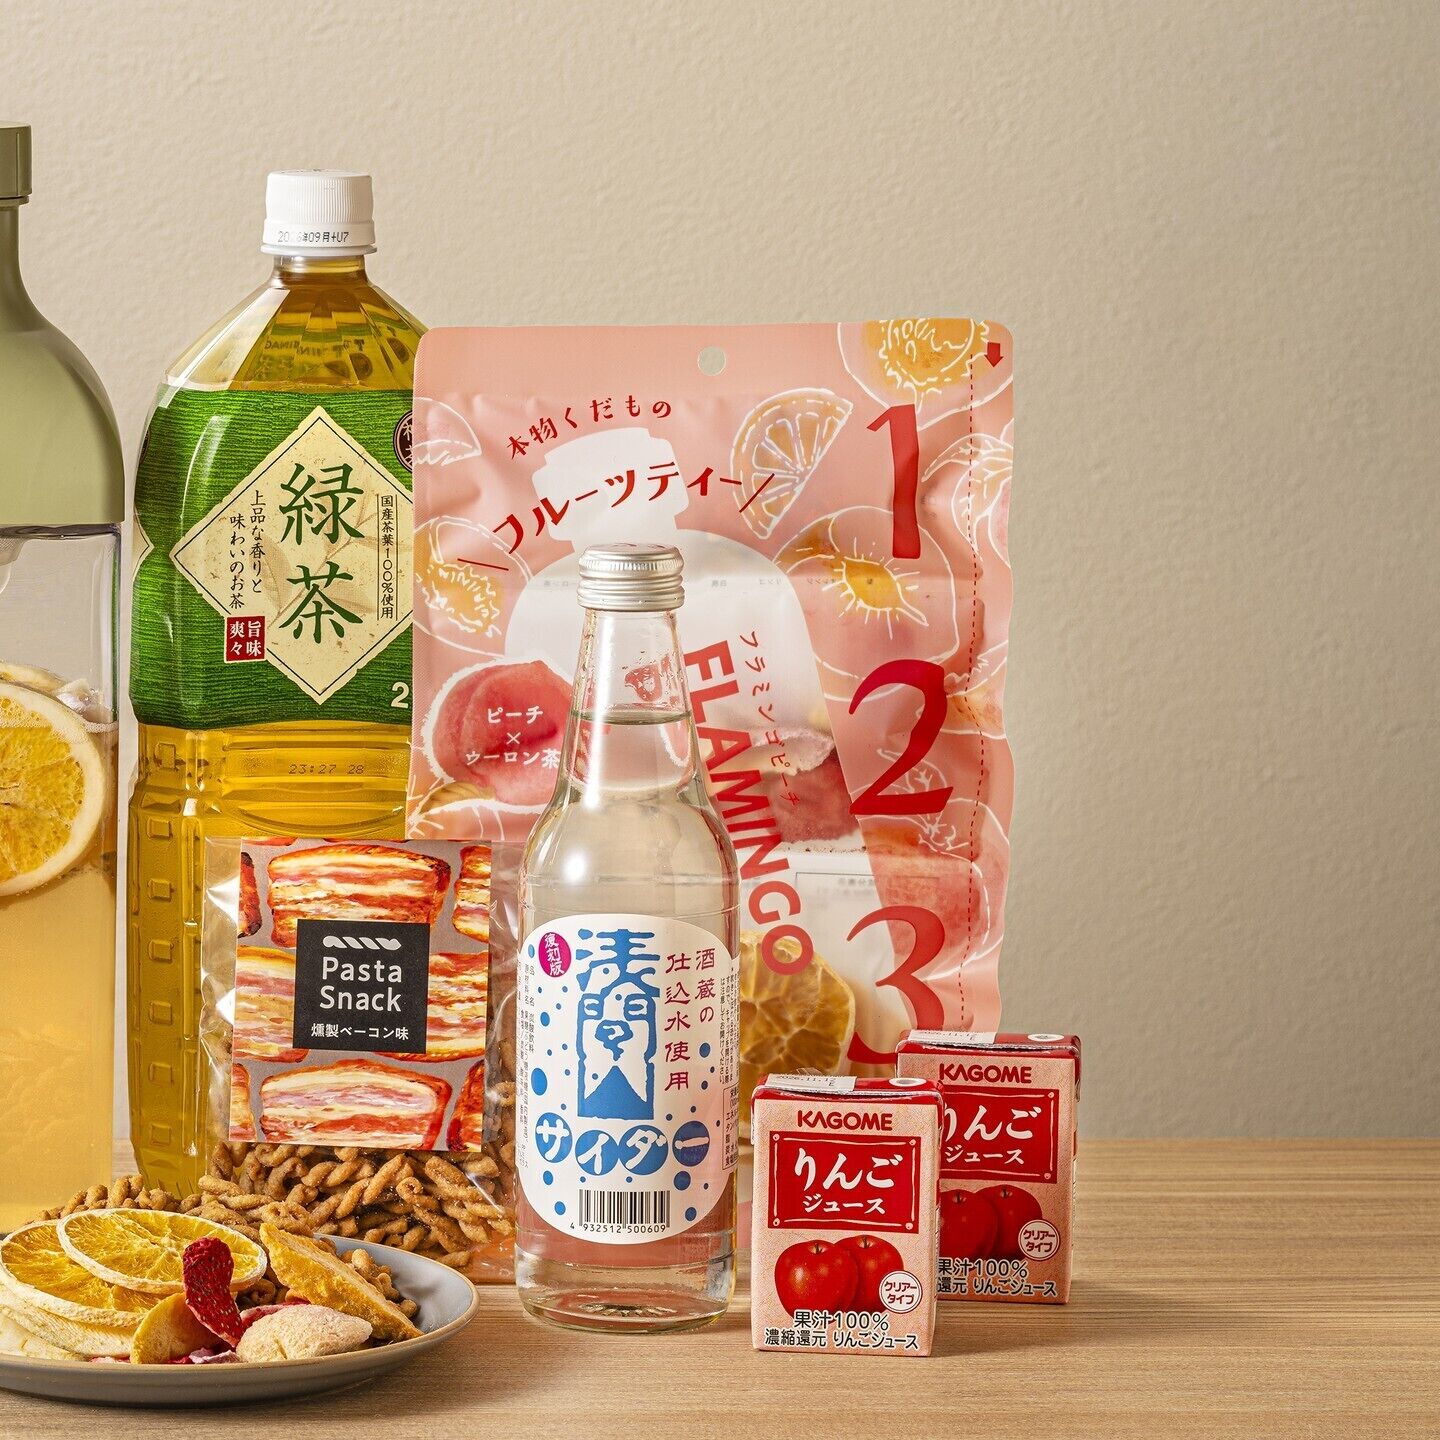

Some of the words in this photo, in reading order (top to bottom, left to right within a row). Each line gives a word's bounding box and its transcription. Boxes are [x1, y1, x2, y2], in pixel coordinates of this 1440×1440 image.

[506, 394, 672, 460] 本物くだもの
[866, 404, 921, 559] 1
[492, 461, 742, 554] フルーツティー
[250, 490, 266, 594] 上品な香りと
[279, 463, 365, 643] 緑茶
[229, 513, 245, 609] 味わいのお茶
[380, 495, 394, 619] 国産茶葉100%使用
[246, 620, 262, 657] 旨味
[487, 705, 544, 724] ピーチ
[739, 630, 800, 807] フラミンゴピーチ
[848, 659, 954, 816] 2
[288, 764, 337, 774] 23:27
[465, 748, 560, 769] ウーロン茶
[683, 640, 815, 975] FLAMINGO
[544, 933, 565, 976] 復刻版
[322, 956, 402, 983] Pasta
[695, 948, 716, 1022] 酒蔵の
[319, 986, 402, 1012] Snack
[310, 1022, 409, 1041] 燻製ベーコン味
[664, 953, 691, 1092] 仕込水使用
[939, 1063, 1032, 1084] KAGOME
[797, 1110, 893, 1132] KAGOME
[537, 1118, 709, 1174] サイダー
[945, 1144, 1025, 1166] ジュース
[794, 1147, 902, 1192] りんご
[802, 1193, 886, 1215] ジュース
[583, 1223, 622, 1235] 932512
[627, 1223, 667, 1235] 500609
[1022, 1229, 1055, 1241] クリアー
[1025, 1240, 1053, 1254] タイプ
[937, 1258, 1029, 1279] 果汁100%
[884, 1280, 917, 1293] クリアー
[886, 1292, 915, 1305] タイプ
[936, 1275, 967, 1295] 還元
[973, 1276, 1057, 1297] りんごジュース
[793, 1310, 890, 1331] 果汁100%
[764, 1329, 827, 1348] 濃縮還元
[832, 1331, 919, 1350] りんごジュース
